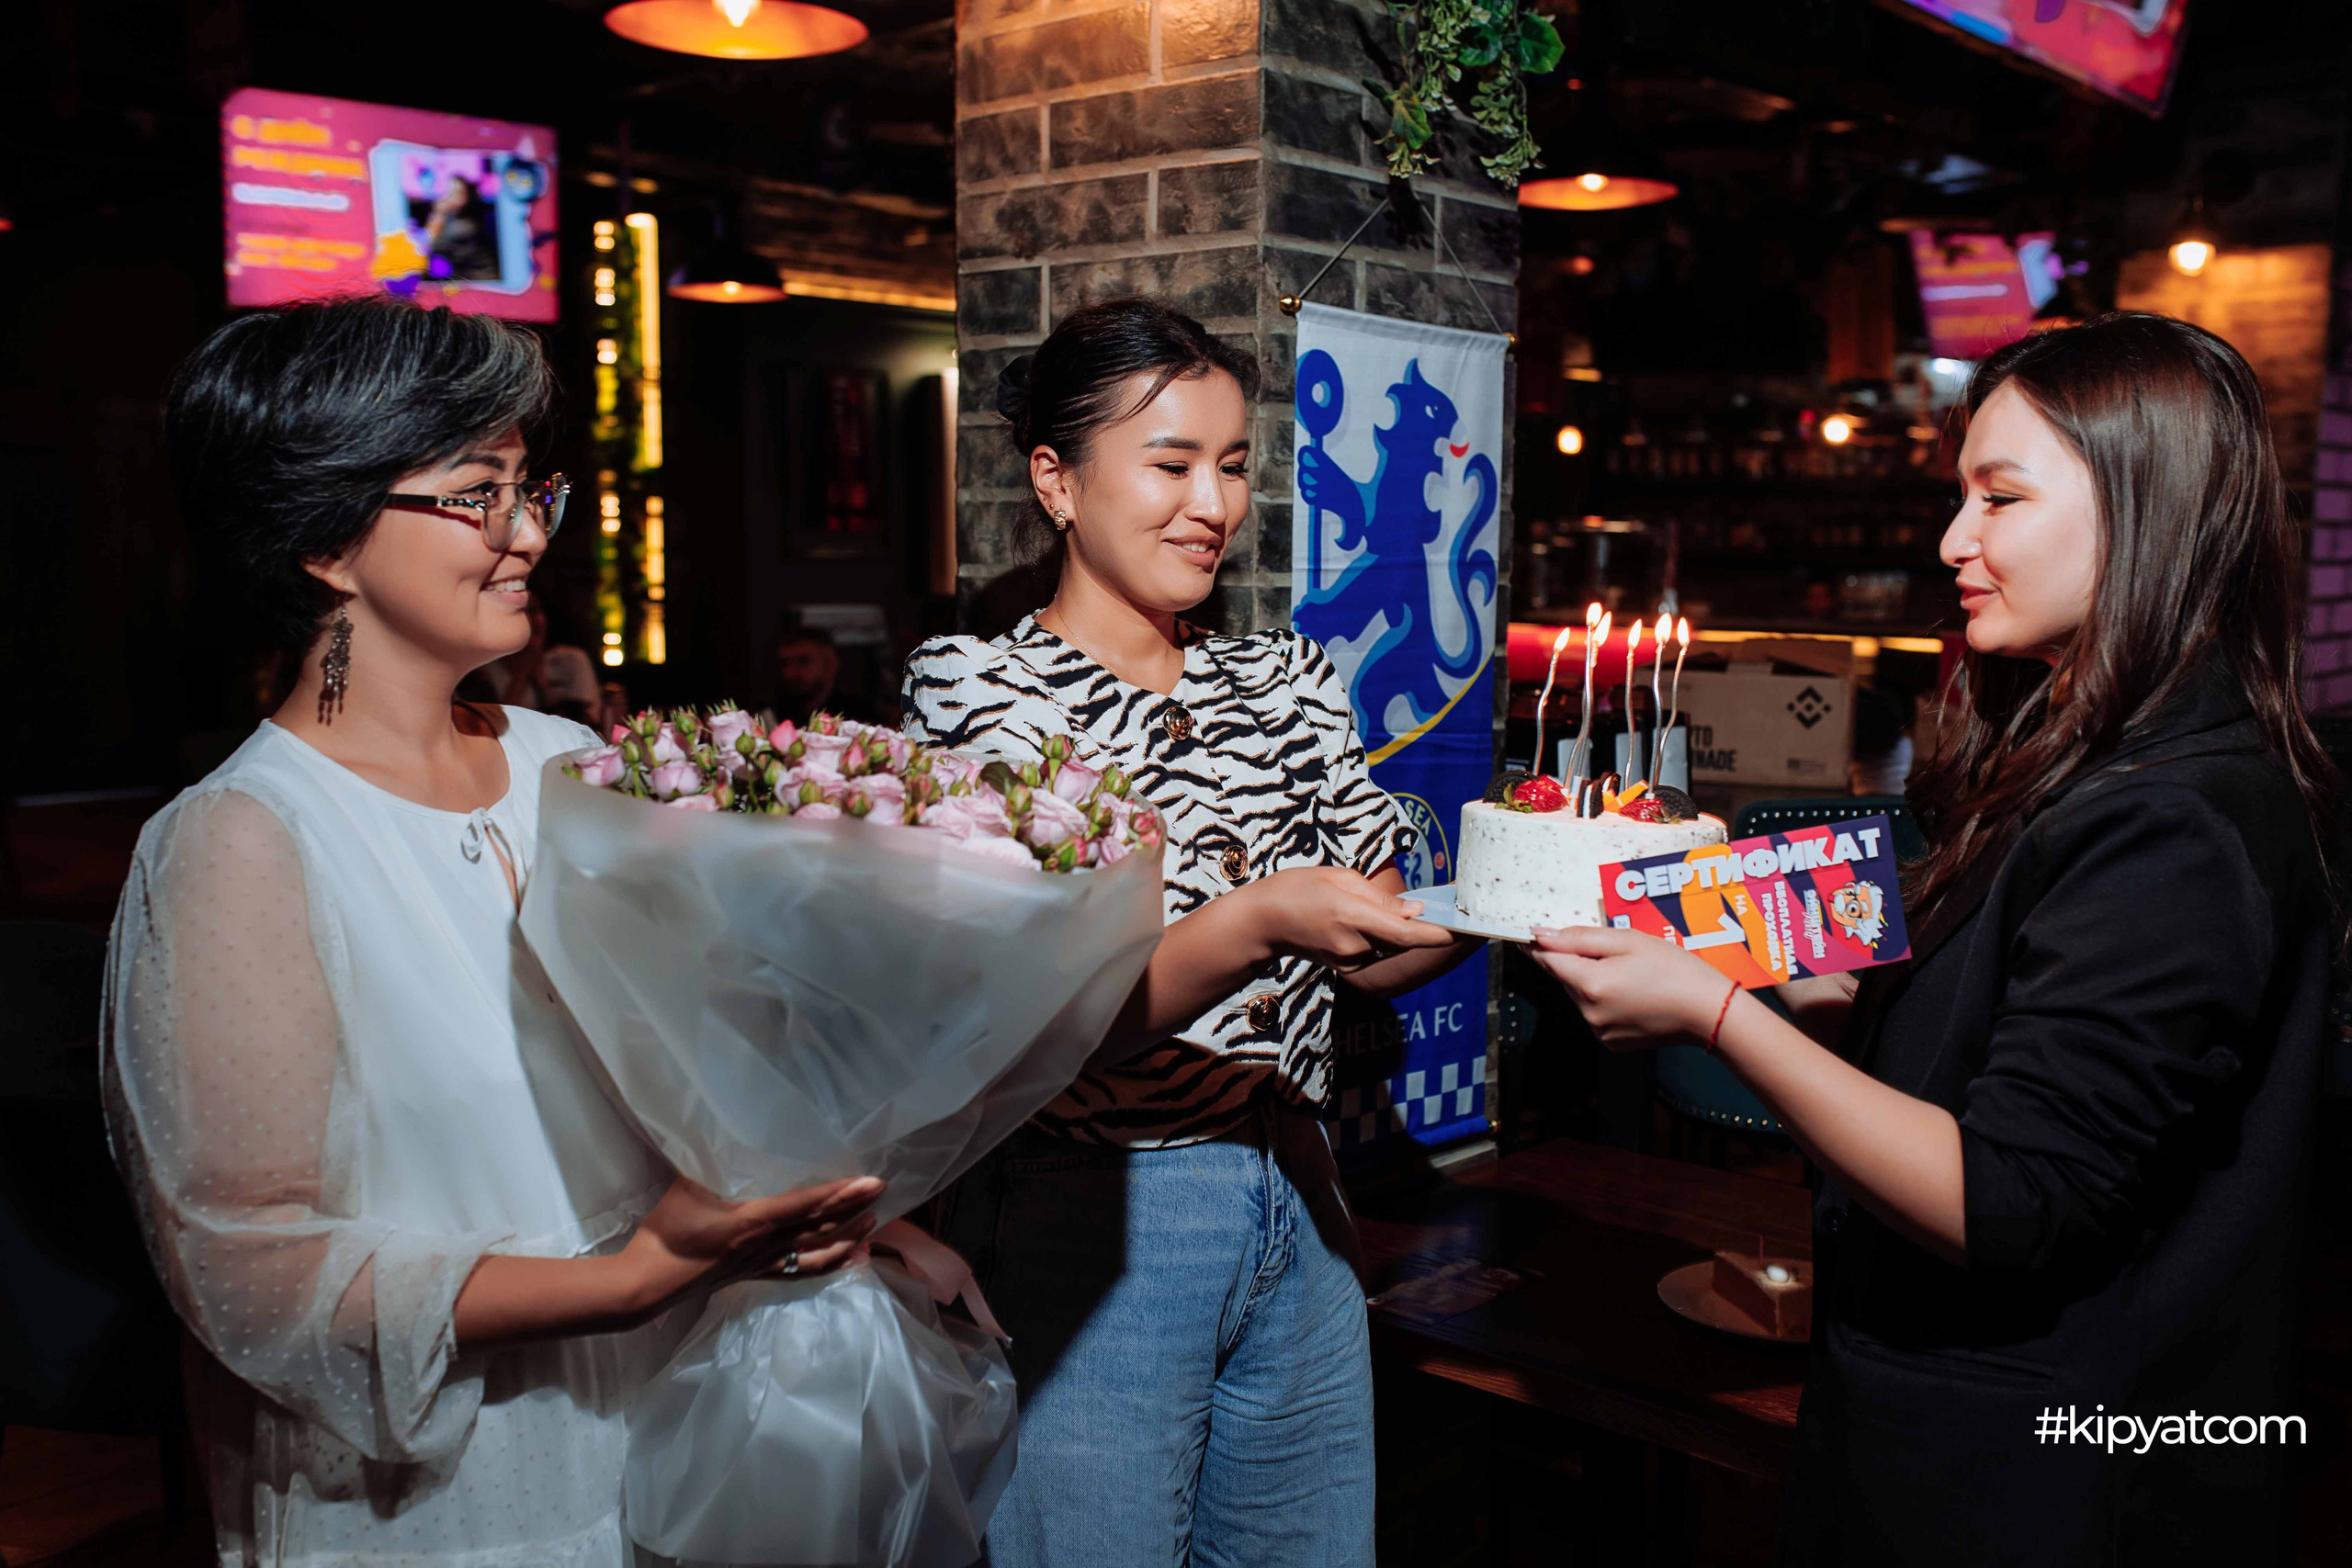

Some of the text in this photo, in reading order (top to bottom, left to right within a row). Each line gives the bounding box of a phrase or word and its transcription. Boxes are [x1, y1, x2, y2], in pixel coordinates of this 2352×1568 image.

[1403, 799, 1432, 836] SEA
[1615, 828, 1881, 901] СЕРТИФИКАТ
[1735, 893, 1747, 917] НА
[1761, 893, 1782, 972] ПРОХОДКА
[1774, 880, 1798, 976] БЕСПЛАТНАЯ
[1334, 1001, 1464, 1061] HELSEA FC
